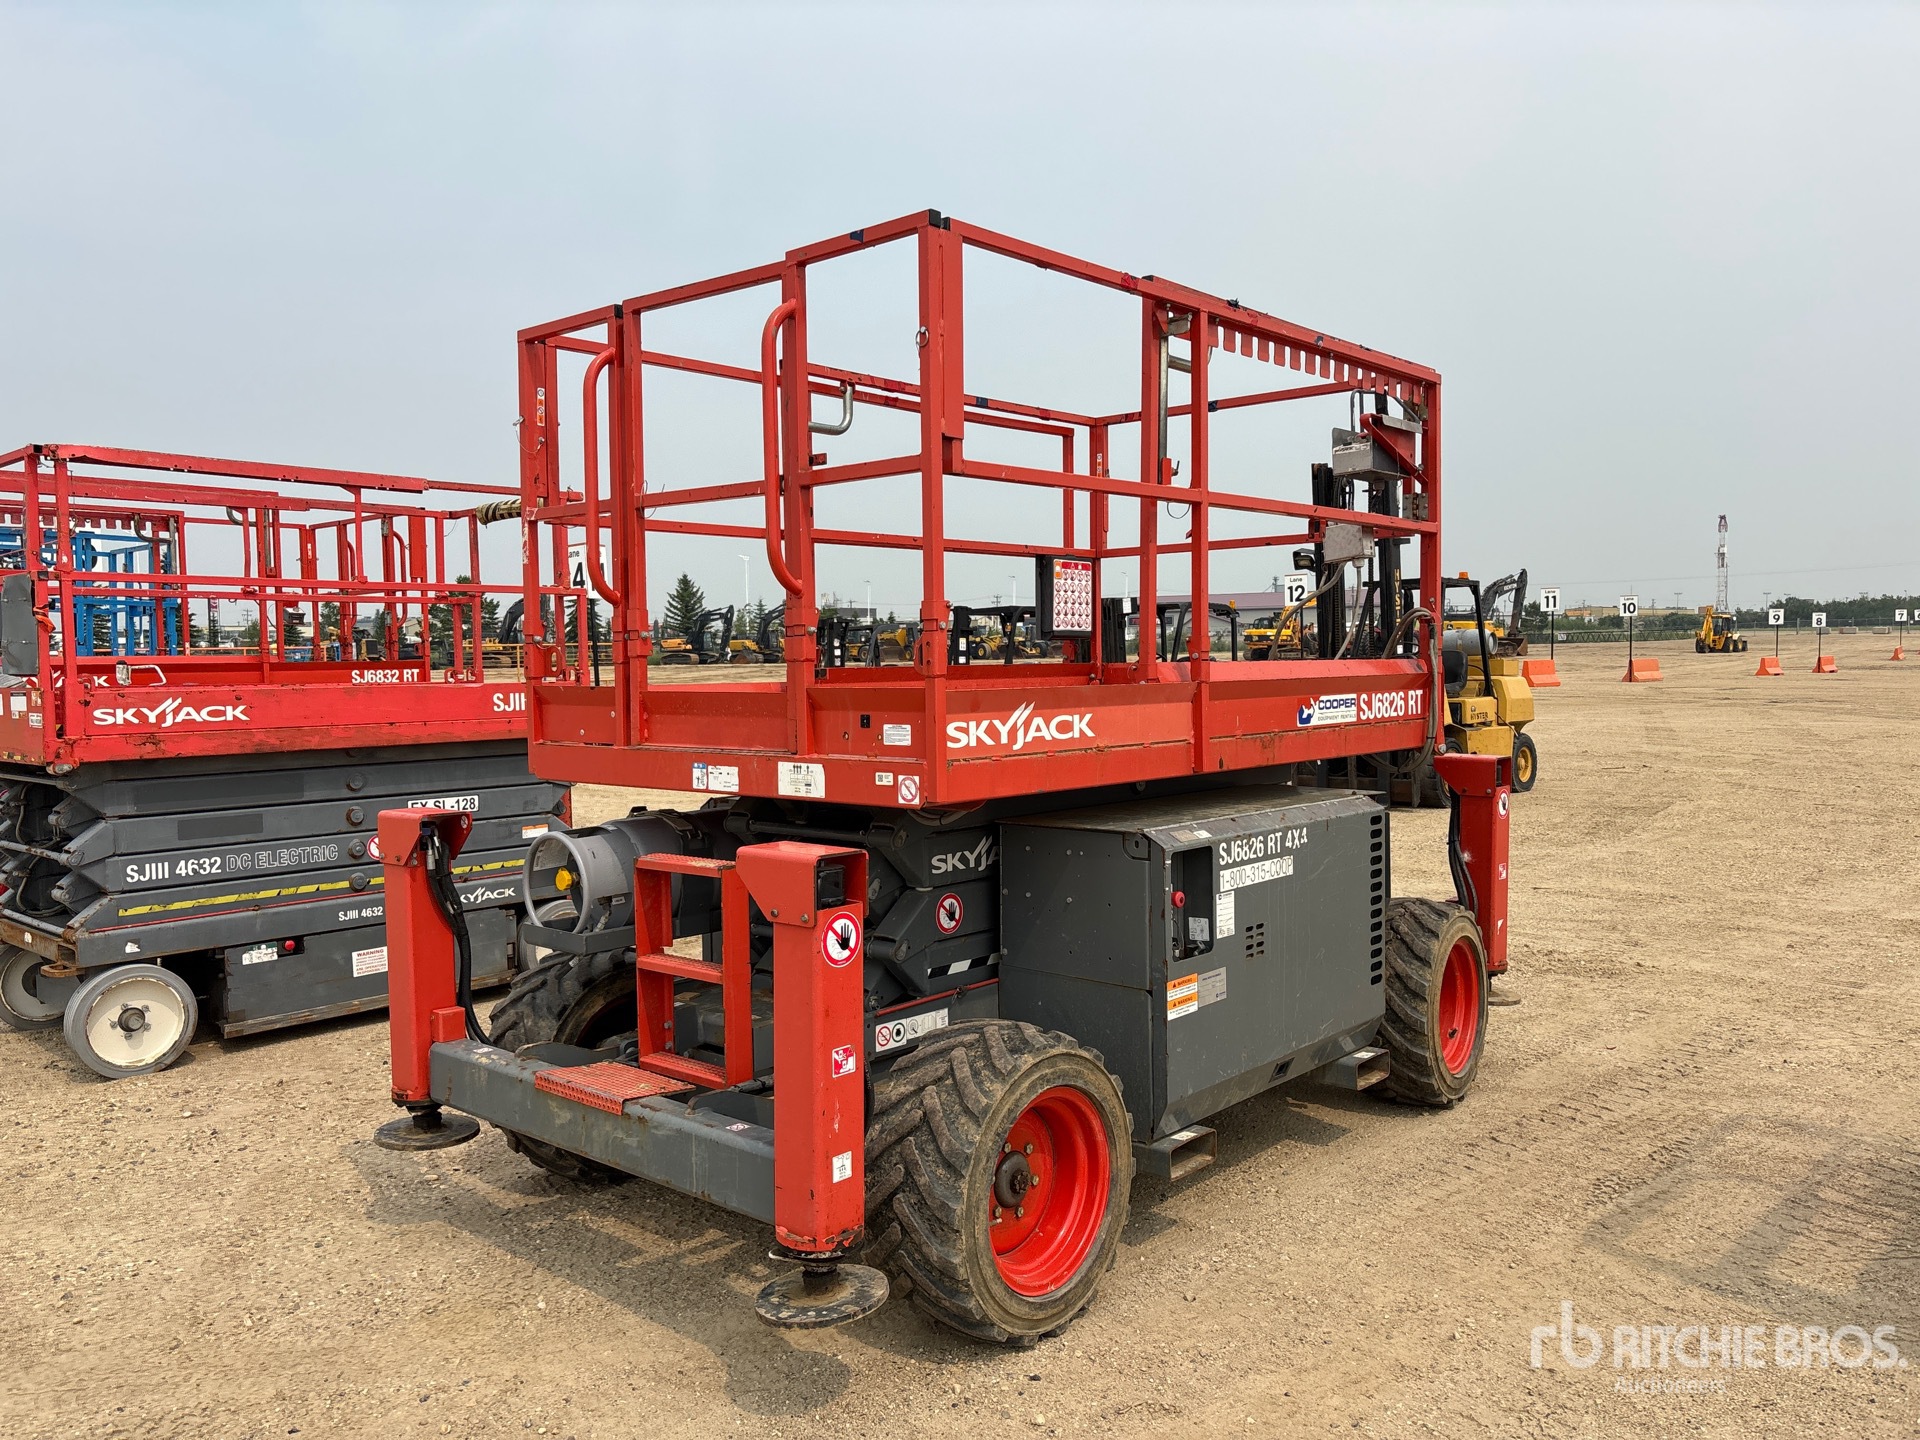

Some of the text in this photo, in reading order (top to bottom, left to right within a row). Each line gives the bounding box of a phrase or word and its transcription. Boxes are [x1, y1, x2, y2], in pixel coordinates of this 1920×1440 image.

[566, 550, 580, 558] ane
[1287, 585, 1306, 602] 12
[1544, 595, 1557, 609] 11
[1622, 602, 1637, 614] 10
[1773, 613, 1781, 623] 9
[1815, 617, 1823, 626] 8
[1897, 612, 1905, 620] 7
[351, 668, 420, 684] SJ6832 RT
[1318, 698, 1356, 710] COOPER
[1360, 689, 1423, 720] SJ6826 RT
[93, 697, 251, 728] SKYJACK
[946, 701, 1096, 751] SKYJACK
[931, 834, 1000, 875] SKYJA
[1219, 835, 1265, 866] SJ6826
[1267, 831, 1283, 855] RT
[126, 844, 339, 883] SJIII 4632 DC ELECTRIC
[1219, 857, 1294, 890] 1-800-315-COOP
[459, 886, 516, 904] KYJACK
[338, 906, 384, 921] SJIII 4632
[357, 949, 384, 957] WARNING
